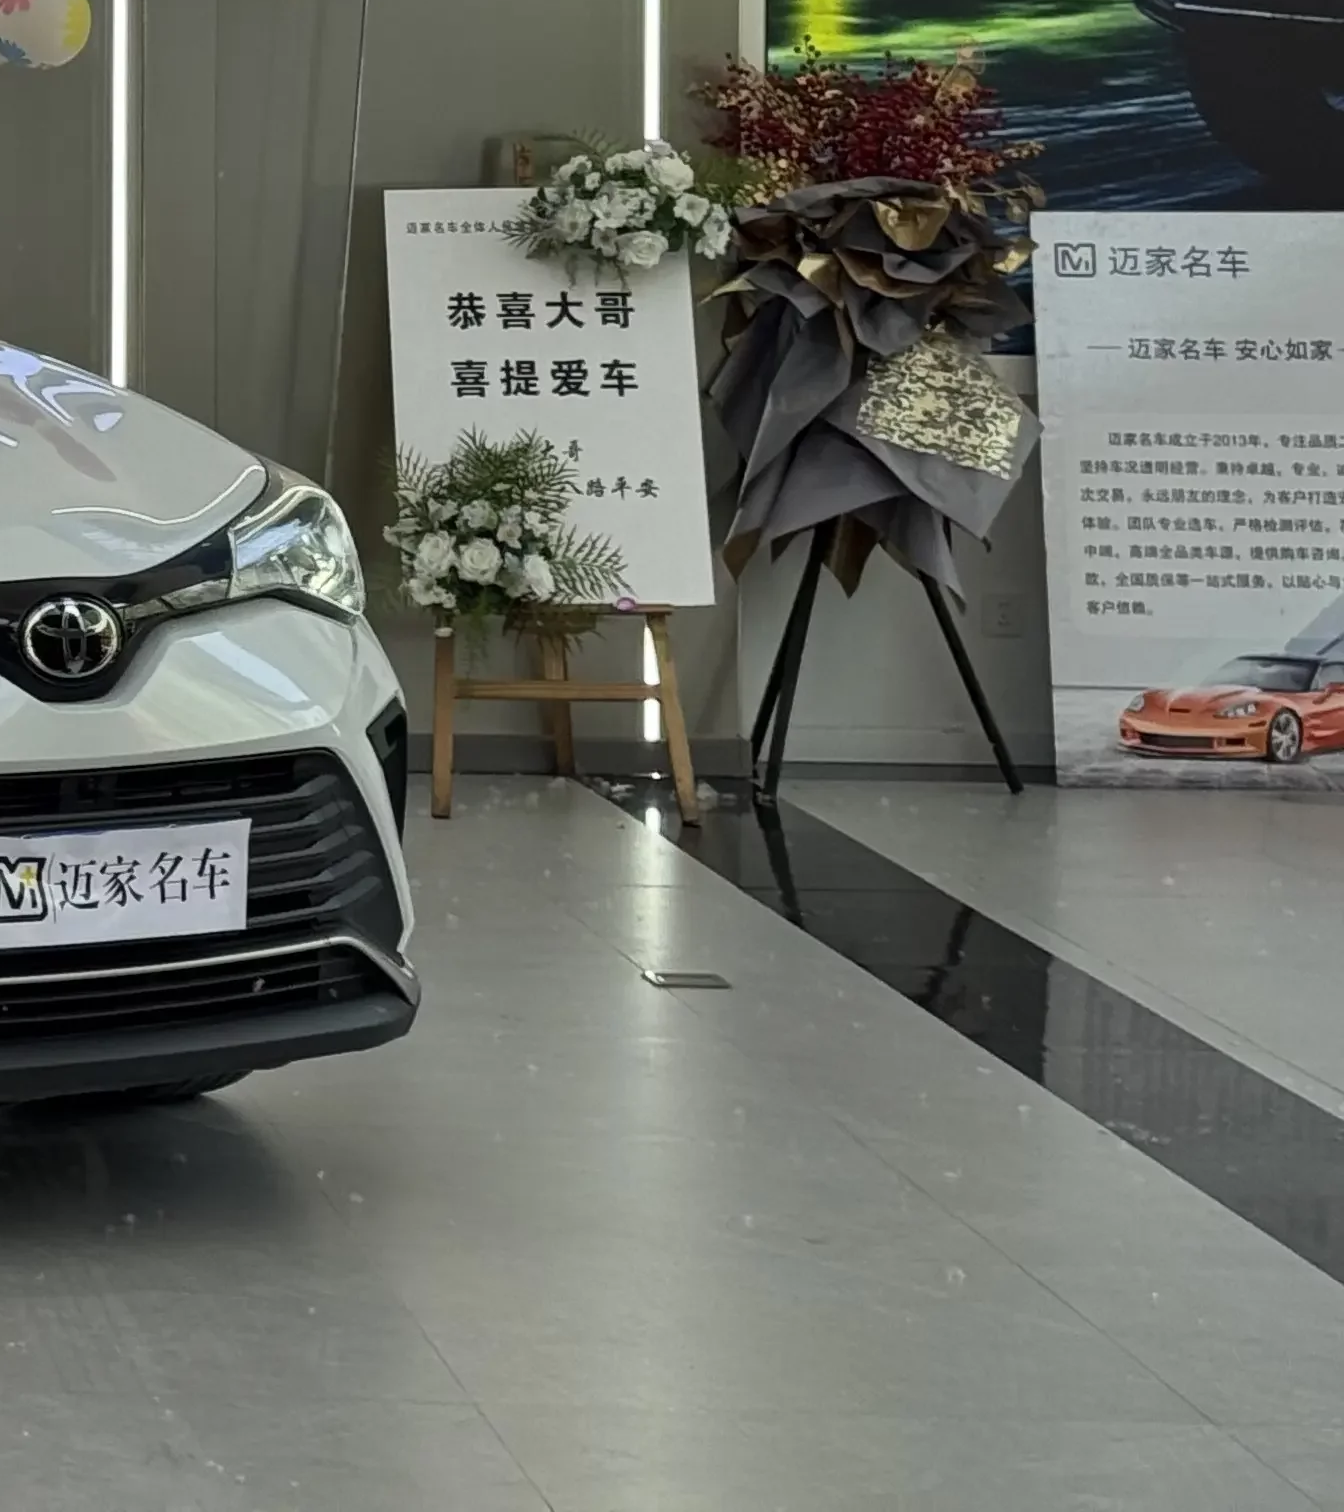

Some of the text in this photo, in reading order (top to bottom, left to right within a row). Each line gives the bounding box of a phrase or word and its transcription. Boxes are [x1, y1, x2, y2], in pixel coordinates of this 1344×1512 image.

[1108, 245, 1250, 278] 迈家名车
[447, 291, 635, 330] 恭喜大哥
[1128, 337, 1333, 361] 迈家名车 安心如家
[451, 359, 639, 398] 喜提爱车
[564, 476, 660, 500] 路平安
[55, 847, 232, 910] 迈家名车
